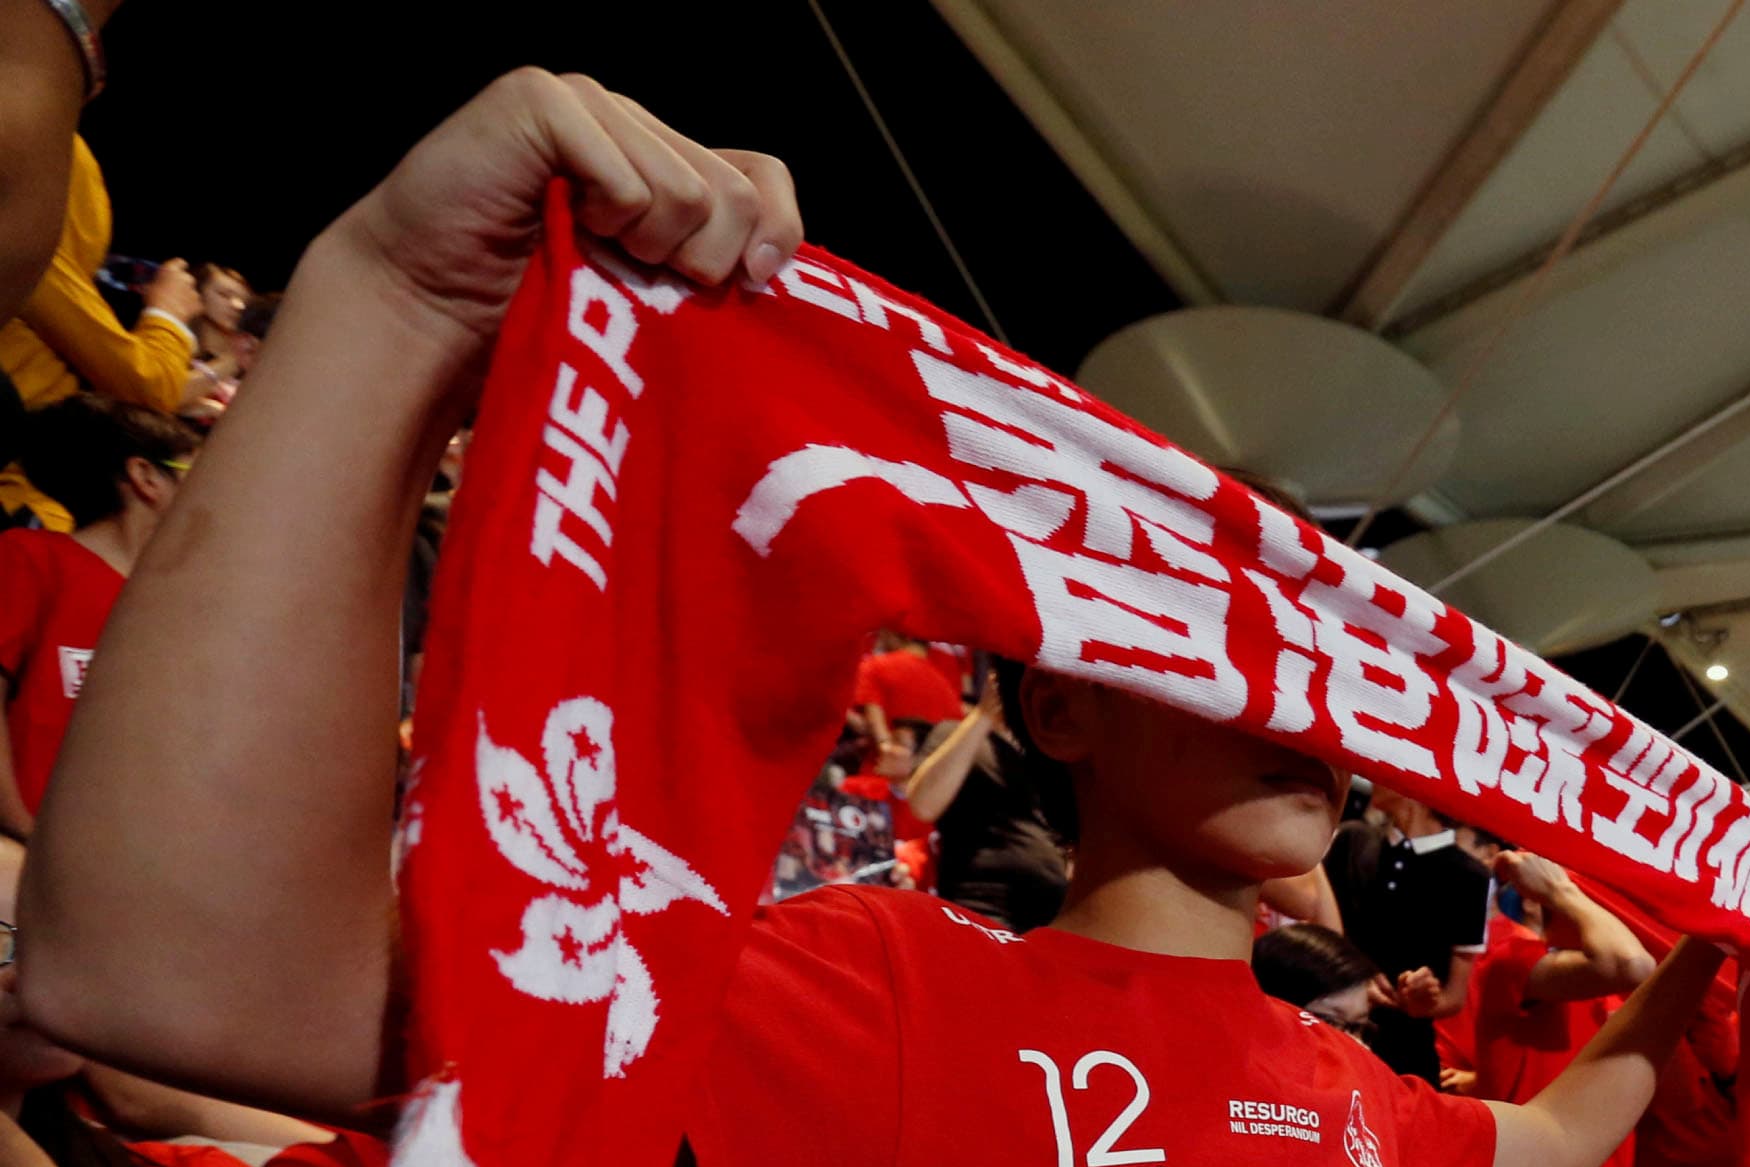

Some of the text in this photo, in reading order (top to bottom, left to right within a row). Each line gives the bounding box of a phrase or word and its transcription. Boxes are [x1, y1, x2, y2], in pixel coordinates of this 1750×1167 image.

[530, 361, 631, 592] THE
[1229, 1100, 1320, 1128] RESURGO
[1230, 1121, 1321, 1144] NIL DESPERANDUM
